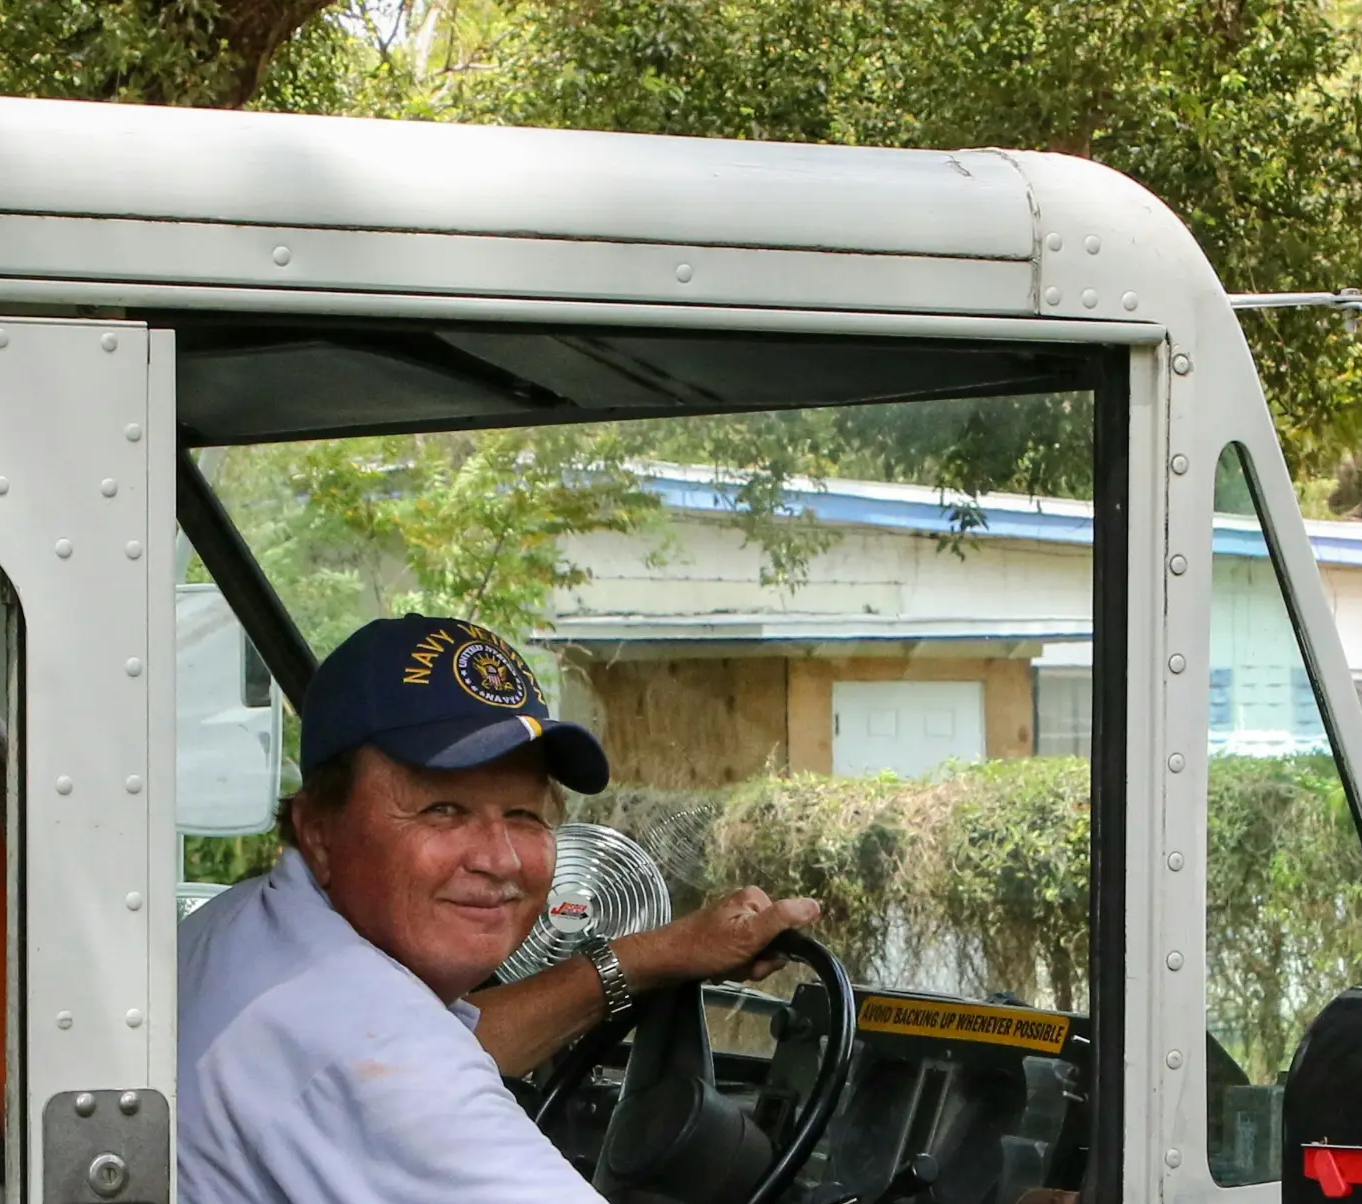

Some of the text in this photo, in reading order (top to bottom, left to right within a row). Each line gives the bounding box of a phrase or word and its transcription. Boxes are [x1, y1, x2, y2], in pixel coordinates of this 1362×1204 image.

[403, 630, 455, 684] NAVY
[459, 645, 484, 668] UNITED
[862, 1004, 1065, 1044] AVOID BACKING UP WHENEVER POSSIBLE
